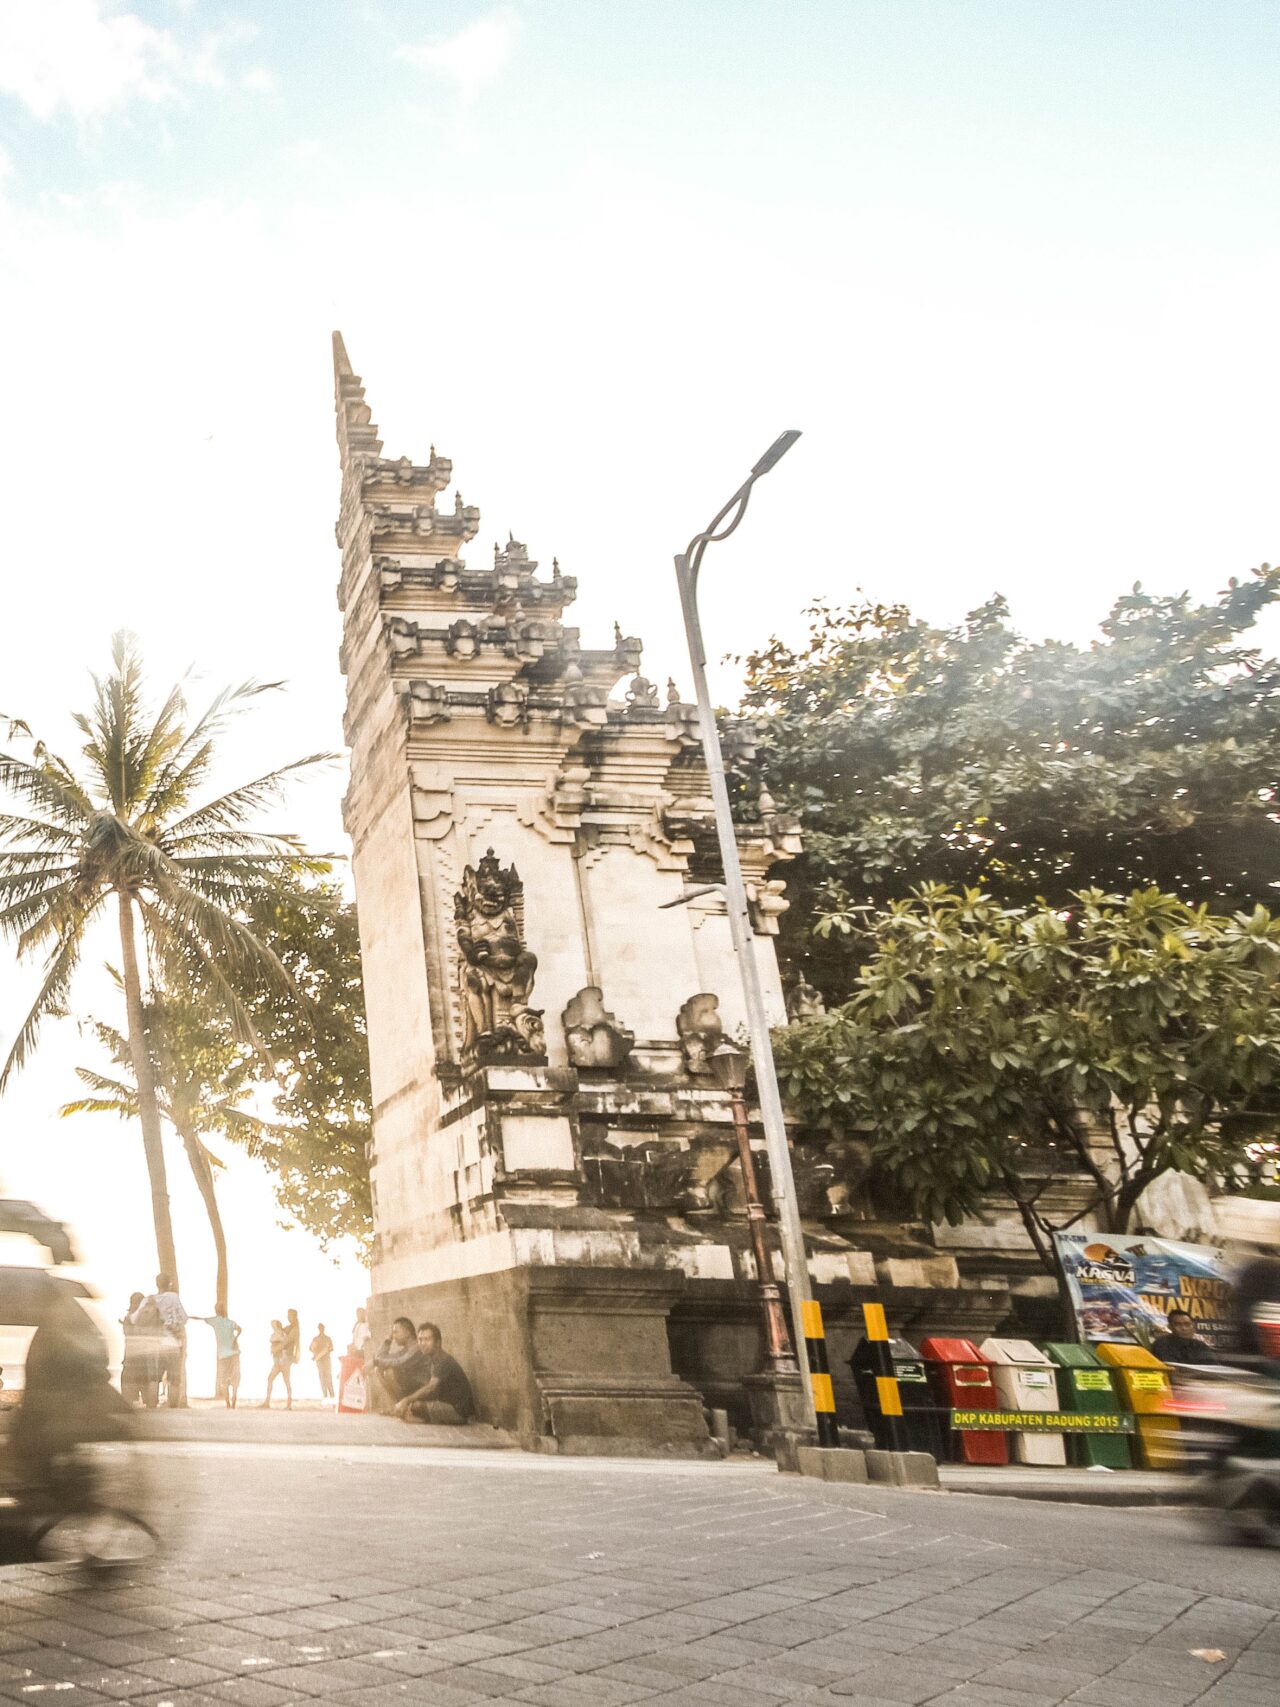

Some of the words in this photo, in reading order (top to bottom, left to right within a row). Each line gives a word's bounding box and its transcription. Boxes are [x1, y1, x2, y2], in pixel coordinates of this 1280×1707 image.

[954, 1412, 976, 1424] DKP
[979, 1413, 1043, 1426] KABUPATEN
[1046, 1415, 1091, 1427] BADUNG
[1093, 1416, 1119, 1427] 2015
